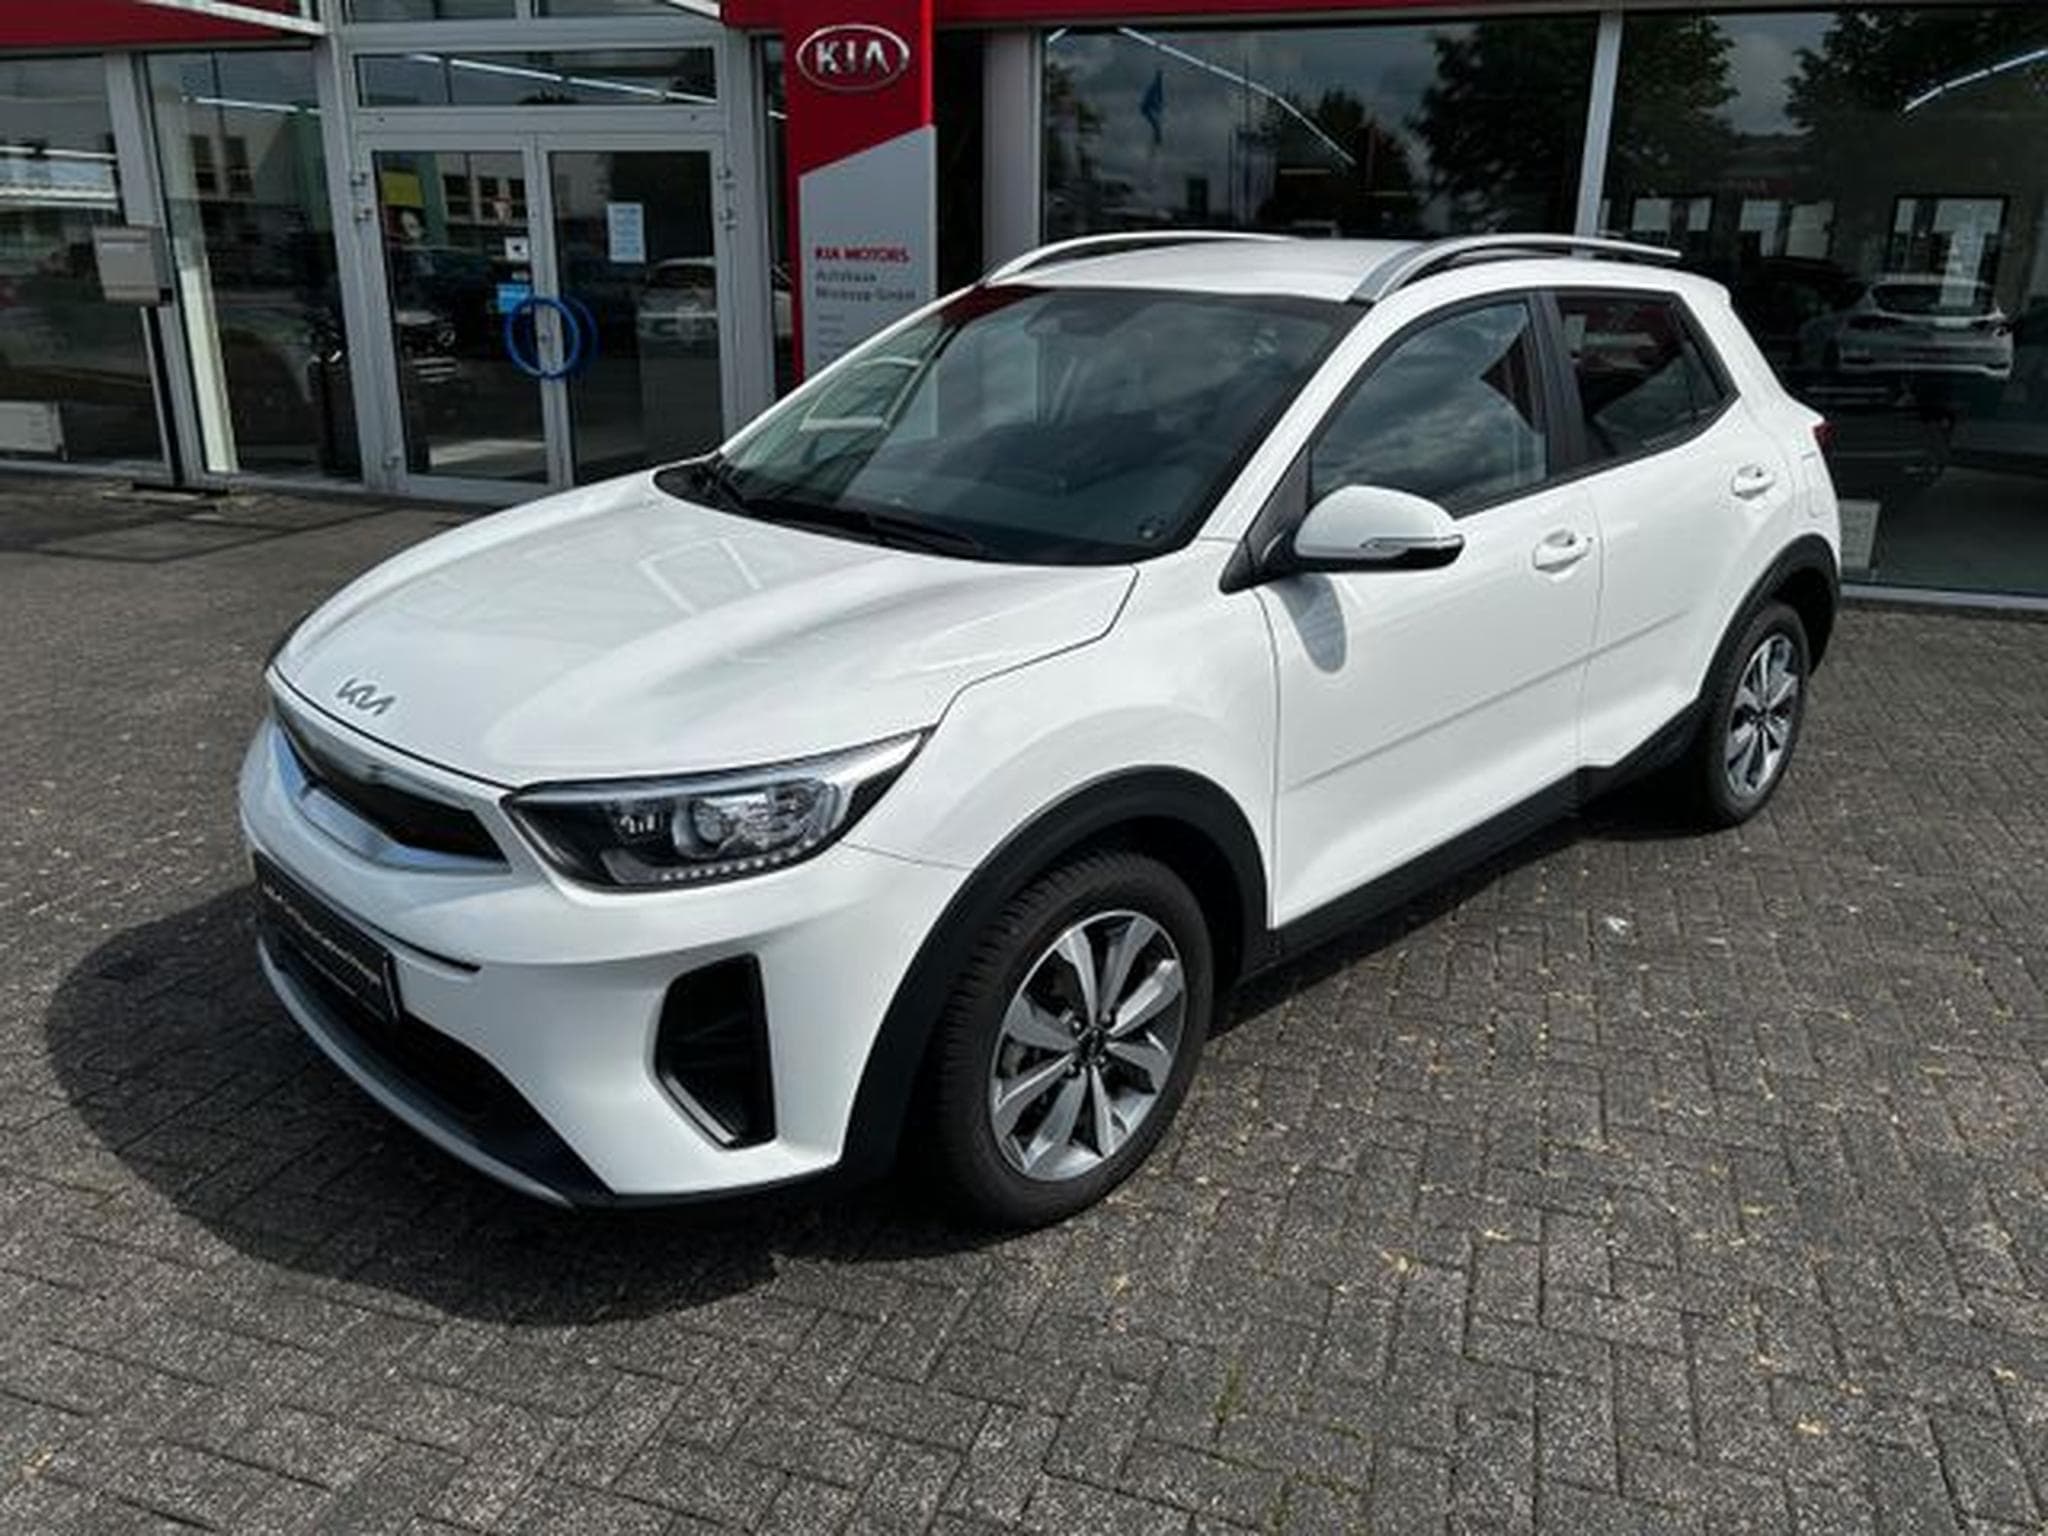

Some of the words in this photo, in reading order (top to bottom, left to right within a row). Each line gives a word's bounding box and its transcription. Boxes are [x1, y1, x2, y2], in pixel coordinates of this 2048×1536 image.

[815, 40, 890, 74] KIA
[815, 246, 839, 262] KIA
[844, 246, 911, 264] MOTORS
